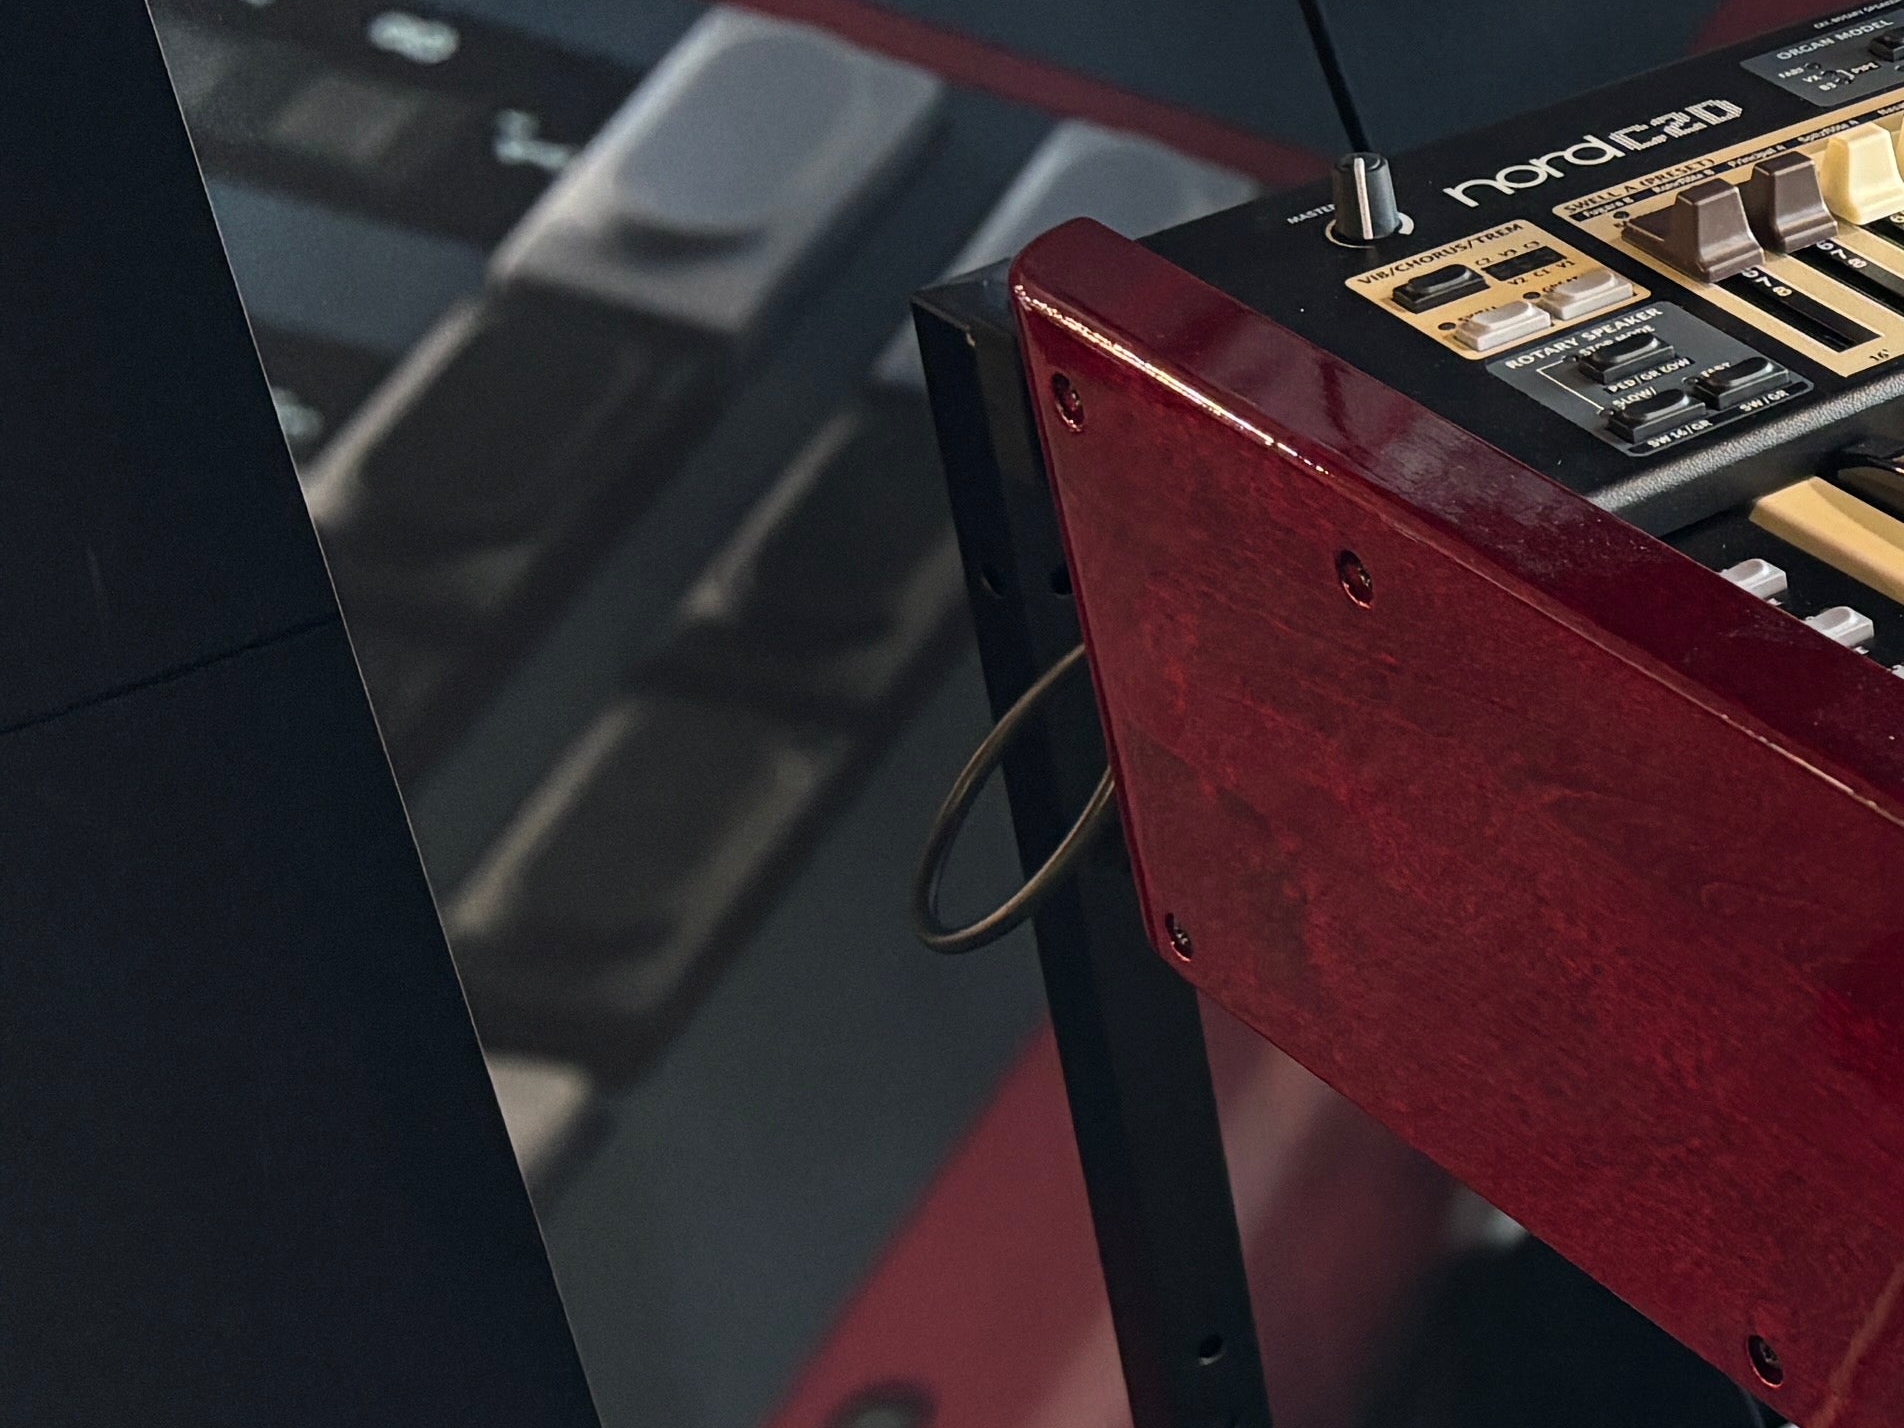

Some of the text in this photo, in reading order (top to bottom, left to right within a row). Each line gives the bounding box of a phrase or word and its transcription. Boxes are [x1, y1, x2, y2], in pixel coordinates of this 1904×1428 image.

[1776, 18, 1895, 61] ORGAN MODEL
[1563, 158, 1716, 214] SWELL A (PRESET)
[1357, 223, 1524, 285] VIB/CHORUS/TREM
[1475, 257, 1494, 266] C2
[1498, 248, 1519, 258] V3
[1507, 277, 1528, 286] V2
[1556, 260, 1576, 269] V1
[1505, 308, 1664, 369] ROTARY SPEAKER
[1739, 389, 1790, 412] SW/GR
[1647, 434, 1672, 448] SW
